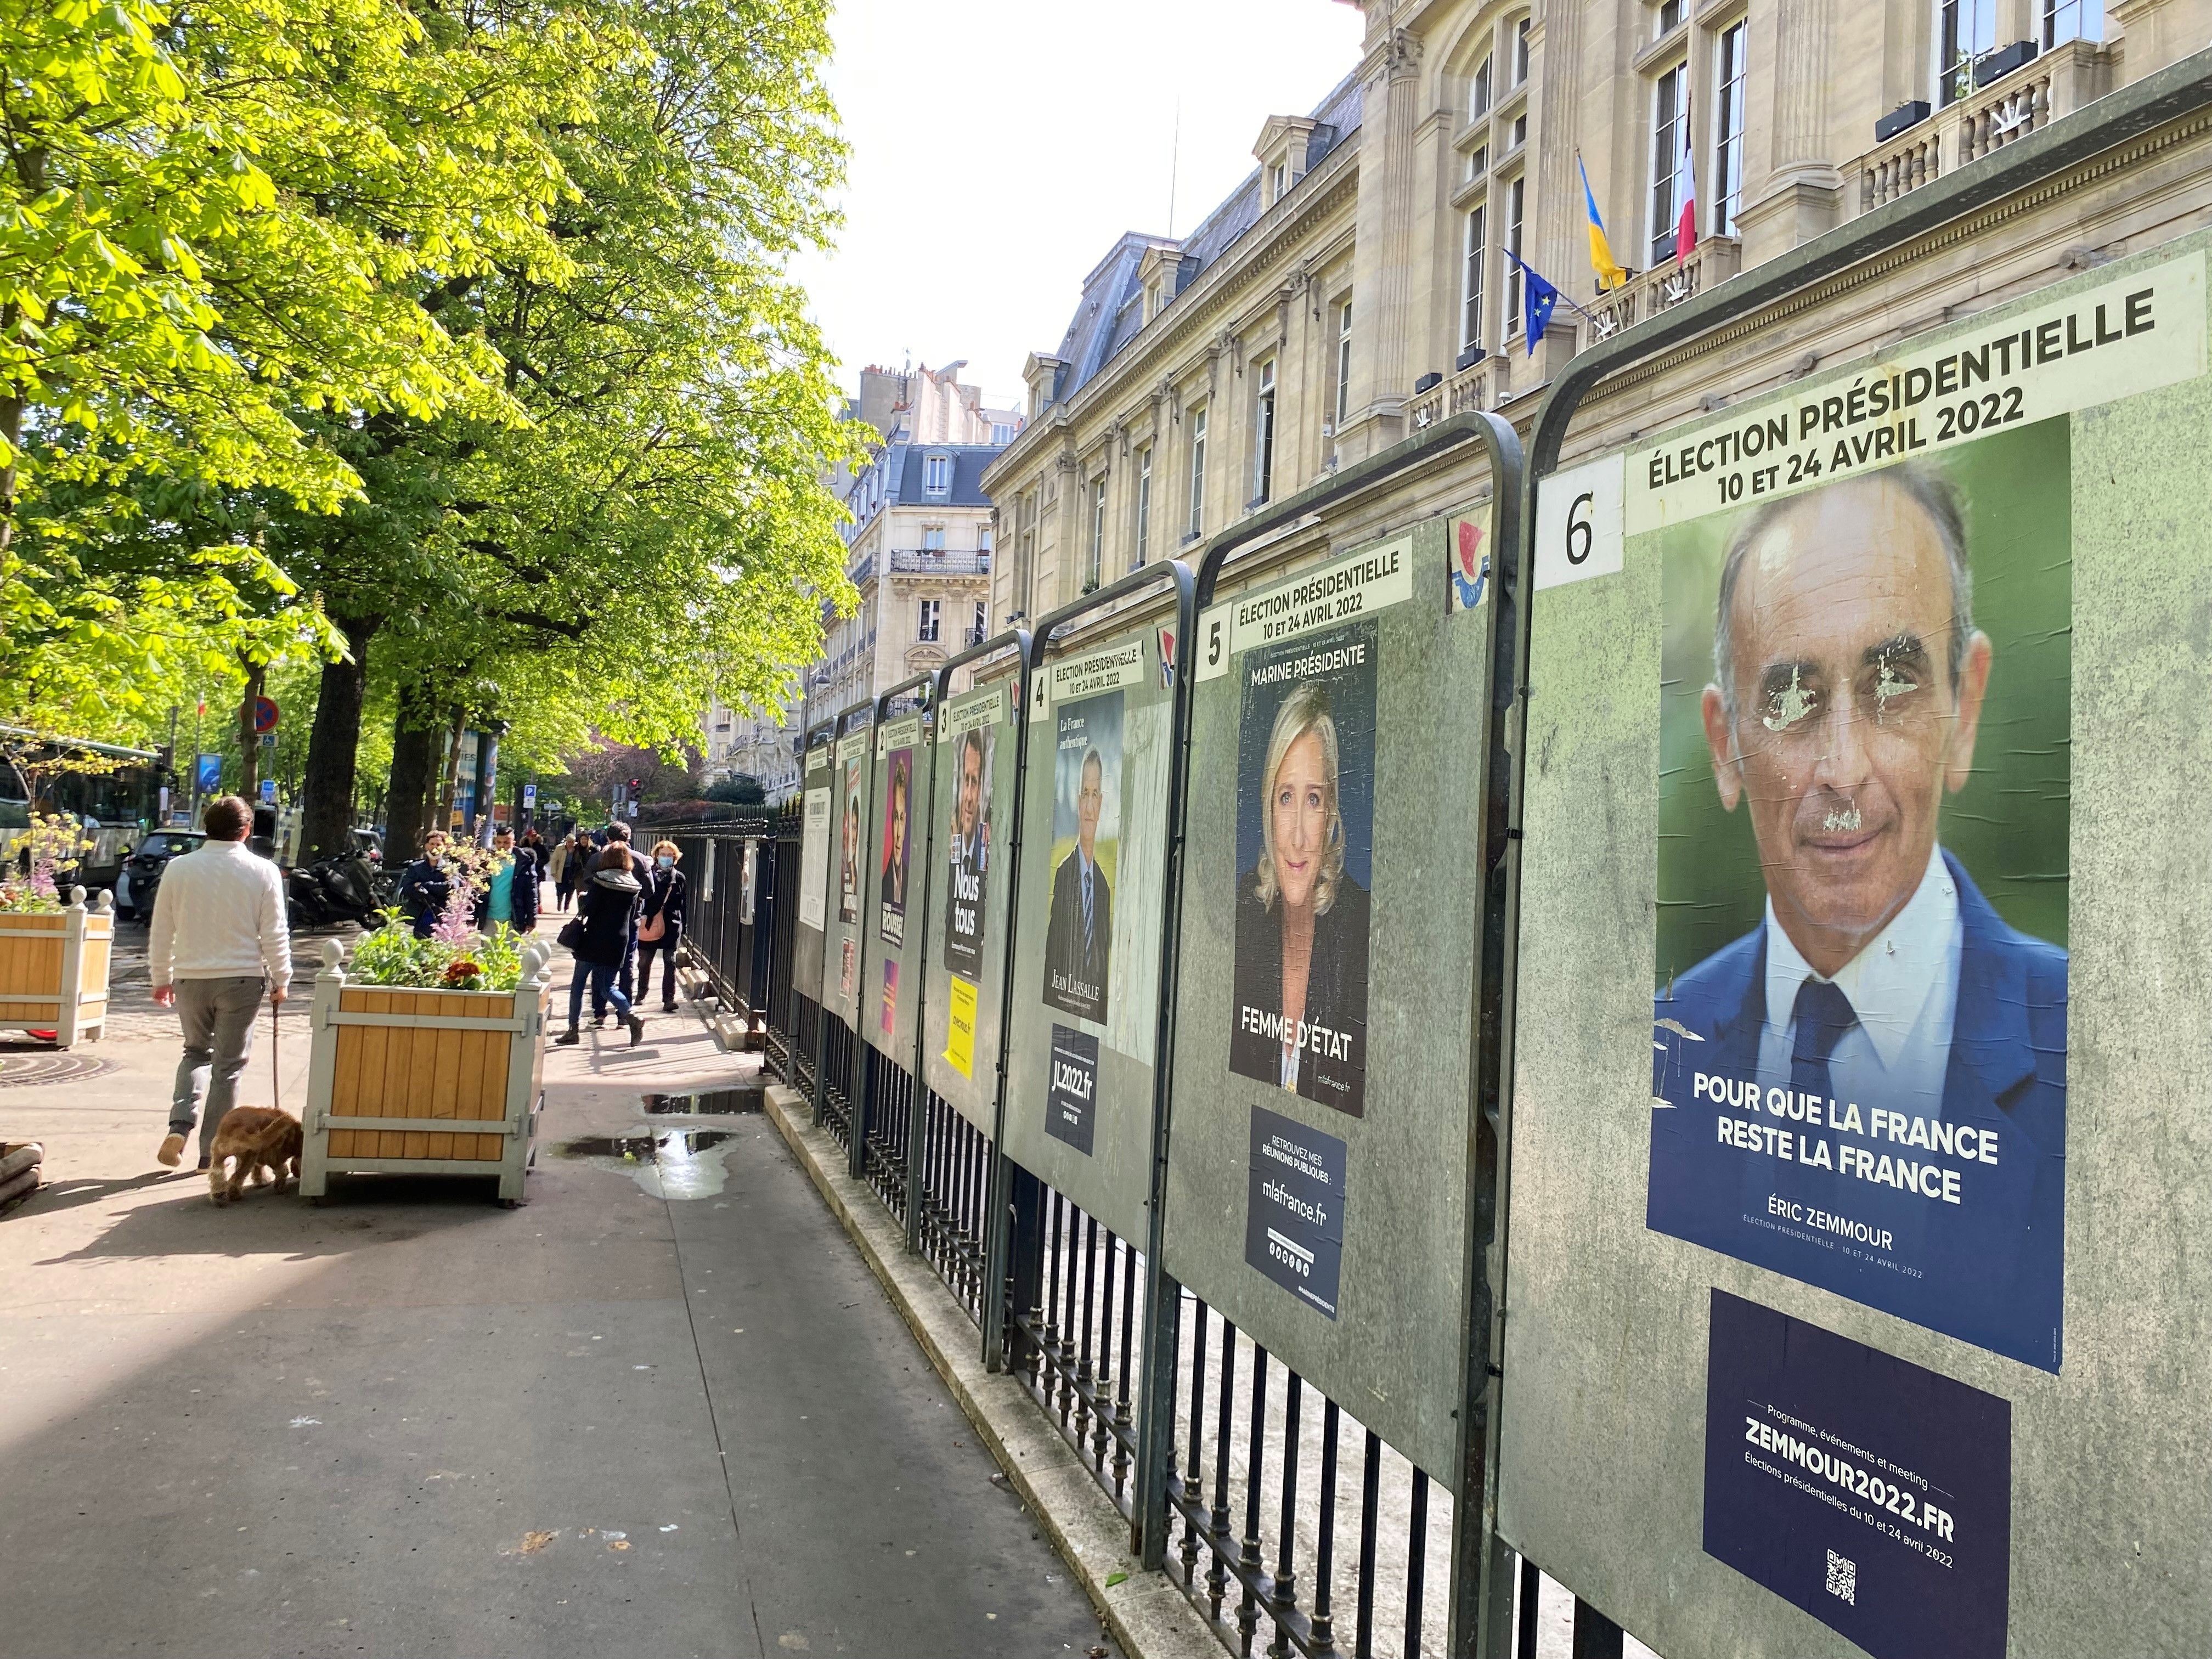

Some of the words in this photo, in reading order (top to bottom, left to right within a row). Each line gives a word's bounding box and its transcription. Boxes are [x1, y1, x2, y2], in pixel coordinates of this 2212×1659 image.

[1649, 414, 1790, 489] ÉLECTION
[1799, 287, 2155, 439] PRÉSIDENTIELLE
[1718, 476, 1742, 504] 10
[1752, 464, 1782, 494] ET
[1787, 449, 1822, 485] 24
[1830, 419, 1926, 473] AVRIL
[1937, 386, 2024, 439] 2022
[1566, 492, 1593, 566] 6
[1240, 592, 1290, 627] ÉLECTION
[1293, 550, 1400, 609] PRÉSIDENTIELLE
[1263, 623, 1273, 640] 10
[1276, 618, 1285, 634] ET
[1288, 614, 1301, 631] 24
[1302, 603, 1334, 628] AVRIL
[1336, 592, 1362, 618] 2022
[1057, 664, 1082, 682] ÉLECTION
[1085, 649, 1137, 675] PRÉSIDENTIELLE
[1208, 620, 1221, 667] 5
[1251, 661, 1291, 686] MARINE
[1294, 644, 1365, 678] PRÉSIDENTE
[1036, 677, 1043, 707] 4
[1070, 684, 1074, 695] 10
[1076, 682, 1081, 693] ET
[1082, 680, 1088, 692] 24
[1090, 675, 1105, 690] AVRIL
[1106, 672, 1120, 686] 2022
[880, 731, 884, 751] 2
[941, 708, 946, 733] 3
[1059, 733, 1088, 750] authentique
[1060, 720, 1067, 732] La
[1068, 716, 1085, 731] France
[953, 865, 979, 902] Nous
[883, 910, 904, 939] ROUSSEL
[955, 901, 975, 936] tous
[1052, 969, 1066, 991] JEAN
[1068, 973, 1099, 1001] LASSALLE
[1242, 1006, 1293, 1044] FEMME
[1297, 1016, 1352, 1062] D'ÉTAT
[1052, 1060, 1093, 1101] JL2022.fr
[1694, 1072, 1760, 1111] POUR
[1767, 1087, 1822, 1125] QUE
[1830, 1099, 1863, 1135] LA
[1871, 1109, 1999, 1165] FRANCE
[1262, 1143, 1293, 1167] RÉUNIONS
[1294, 1158, 1329, 1183] PUBLIQUES
[1272, 1135, 1308, 1161] RETROUVEZ
[1308, 1153, 1322, 1167] MES
[1718, 1116, 1792, 1160] RESTE
[1799, 1135, 1832, 1171] LA
[1839, 1144, 1961, 1204] FRANCE
[1263, 1179, 1327, 1227] mlafrance.fr
[1768, 1193, 1802, 1222] ÉRIC
[1806, 1208, 1893, 1251] ZEMMOUR
[1743, 1214, 1776, 1230] ÉLECTION
[1842, 1246, 1850, 1254] 10
[1853, 1250, 1862, 1259] ET
[1865, 1254, 1875, 1262] 24
[1877, 1257, 1899, 1272] AVRIL
[1902, 1266, 1923, 1279] 2022
[1768, 1404, 1818, 1437] Programme,
[1820, 1429, 1875, 1463] événements
[1878, 1457, 1887, 1470] et
[1889, 1463, 1928, 1491] meeting
[1745, 1416, 1954, 1543] ZEMMOUR2022.FR
[1745, 1450, 1782, 1479] Élections
[1784, 1471, 1847, 1513] présidentielles
[1850, 1505, 1861, 1521] du
[1864, 1512, 1874, 1526] 10
[1876, 1520, 1886, 1532] et
[1888, 1525, 1901, 1540] 24
[1903, 1534, 1923, 1553] avril
[1926, 1545, 1953, 1568] 2022
